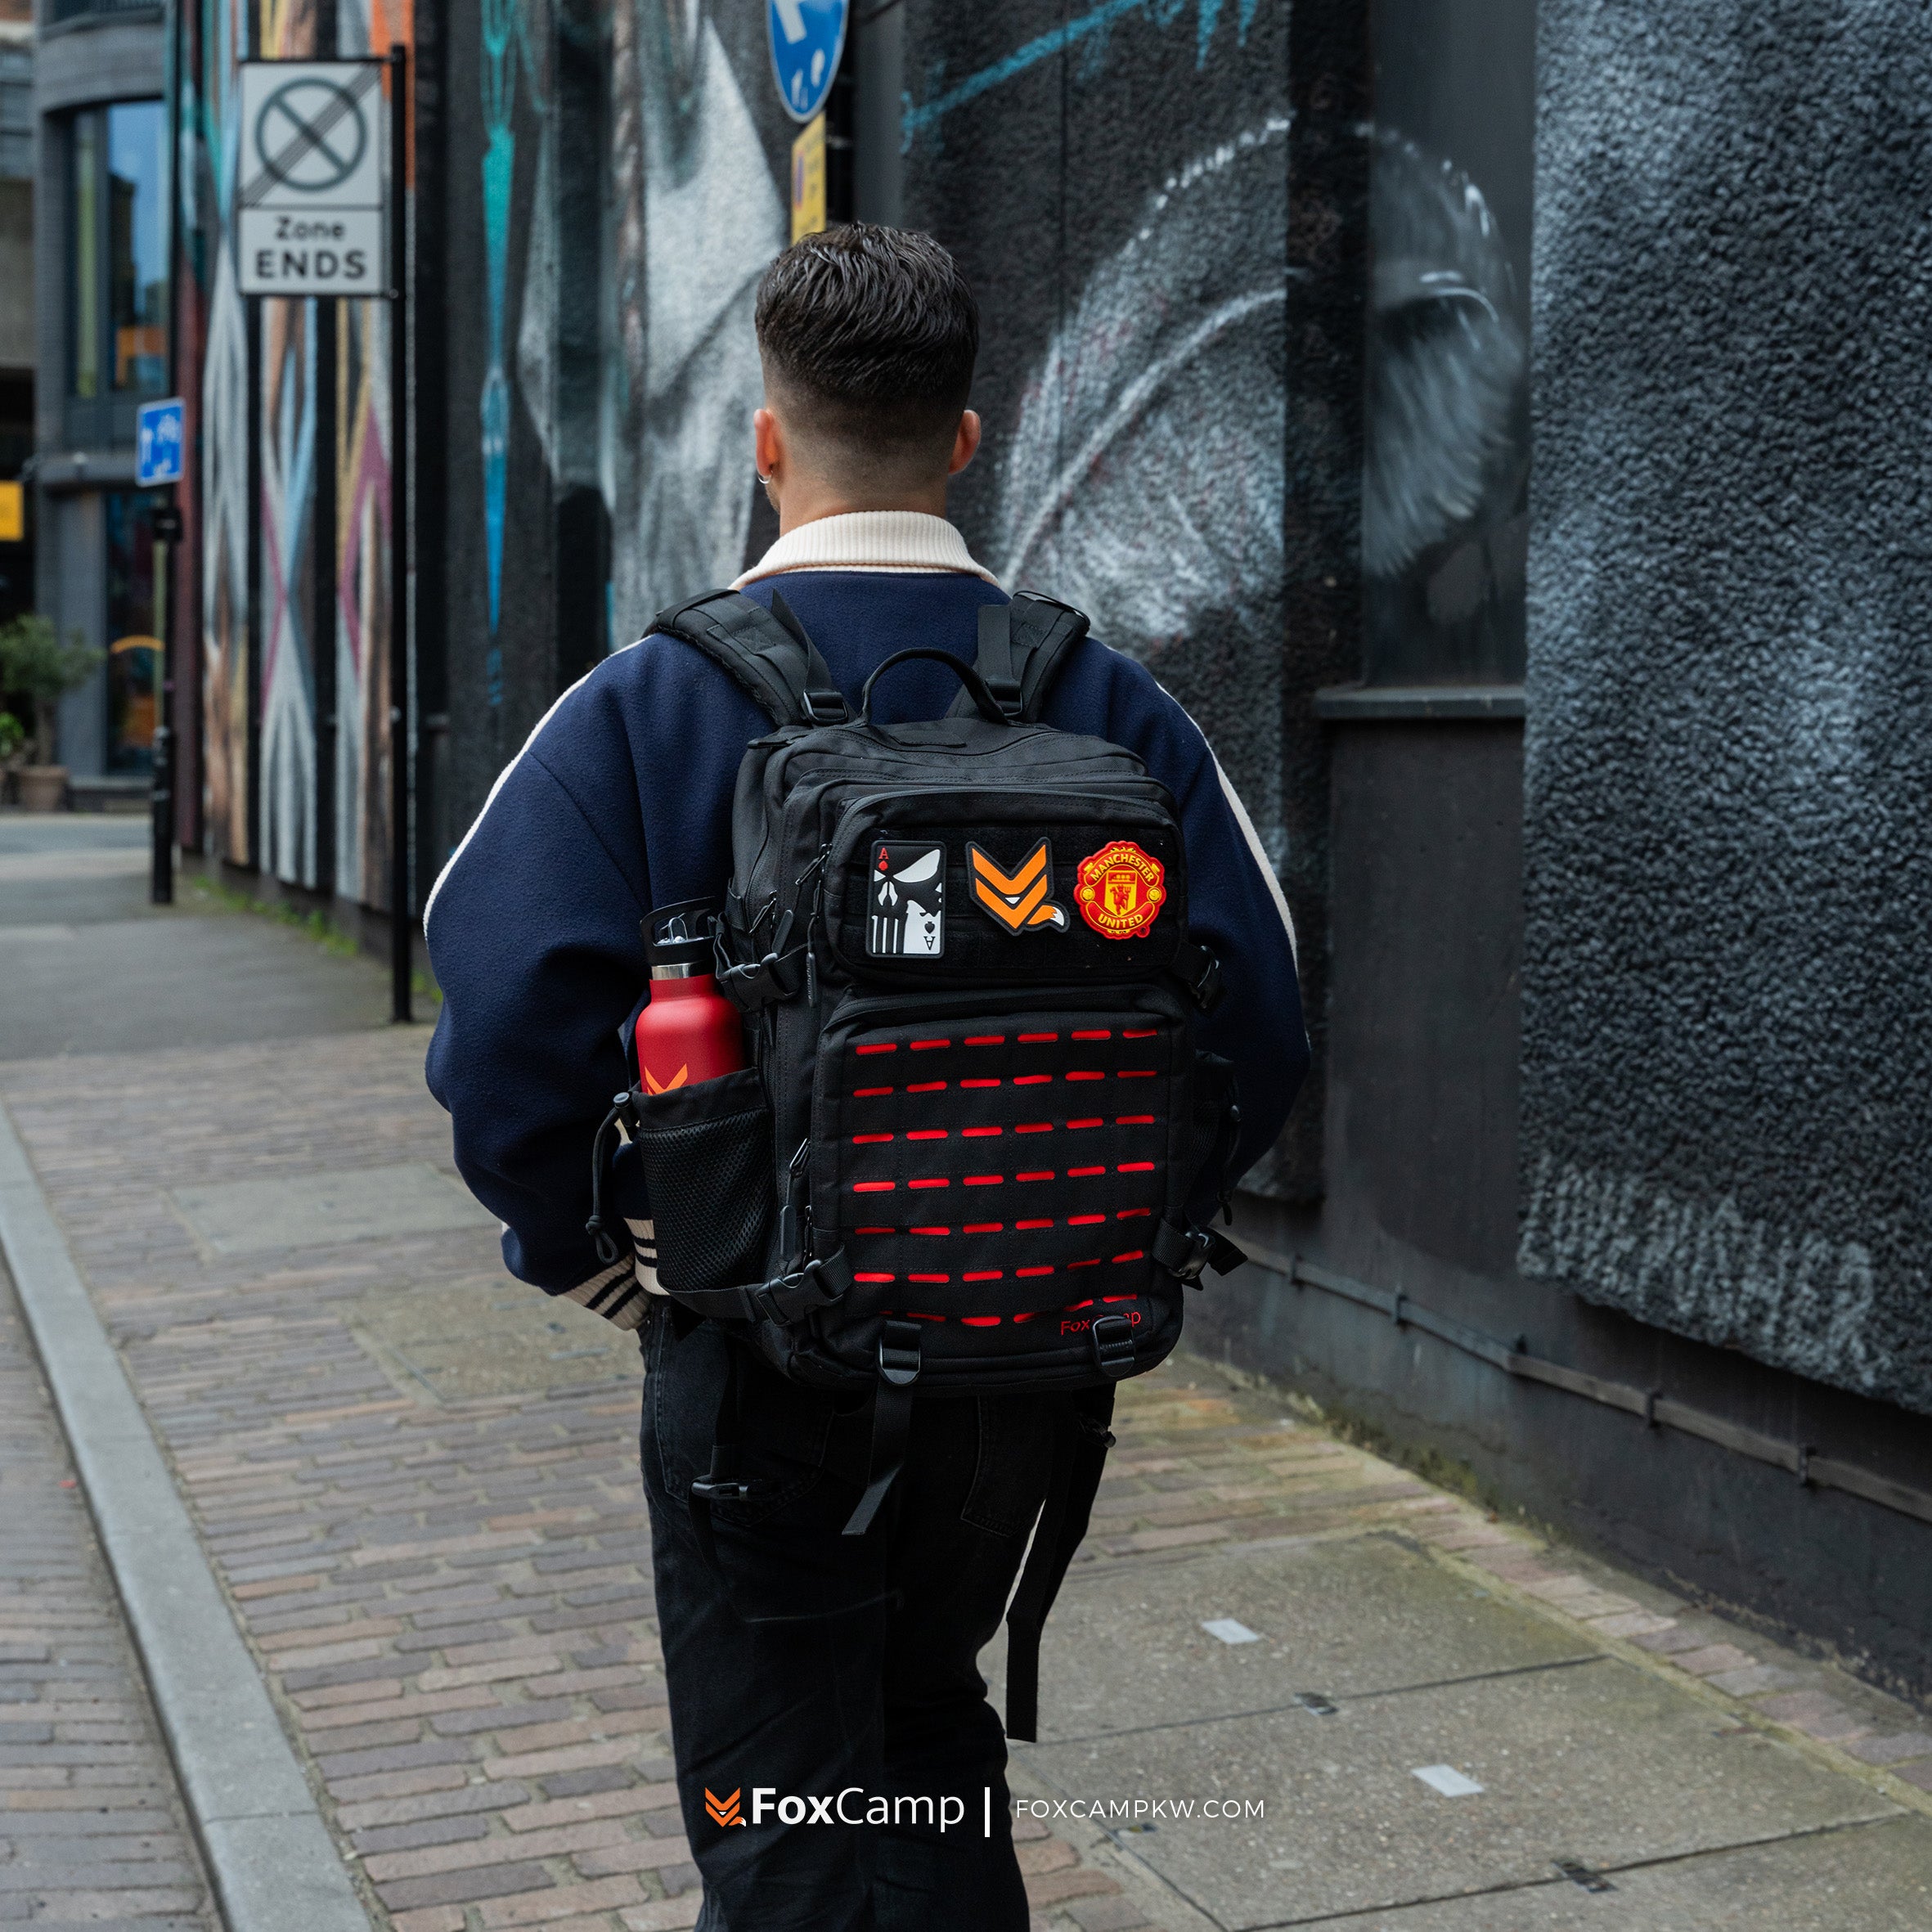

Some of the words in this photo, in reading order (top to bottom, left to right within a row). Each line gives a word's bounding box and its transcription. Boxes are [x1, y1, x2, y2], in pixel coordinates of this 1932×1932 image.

[275, 216, 345, 240] Zone
[255, 249, 366, 280] ENDS
[878, 847, 889, 860] A
[1090, 853, 1154, 882] MANCHESTER
[1098, 914, 1143, 928] UNITED
[923, 936, 936, 950] A
[1060, 1311, 1142, 1336] Foxp
